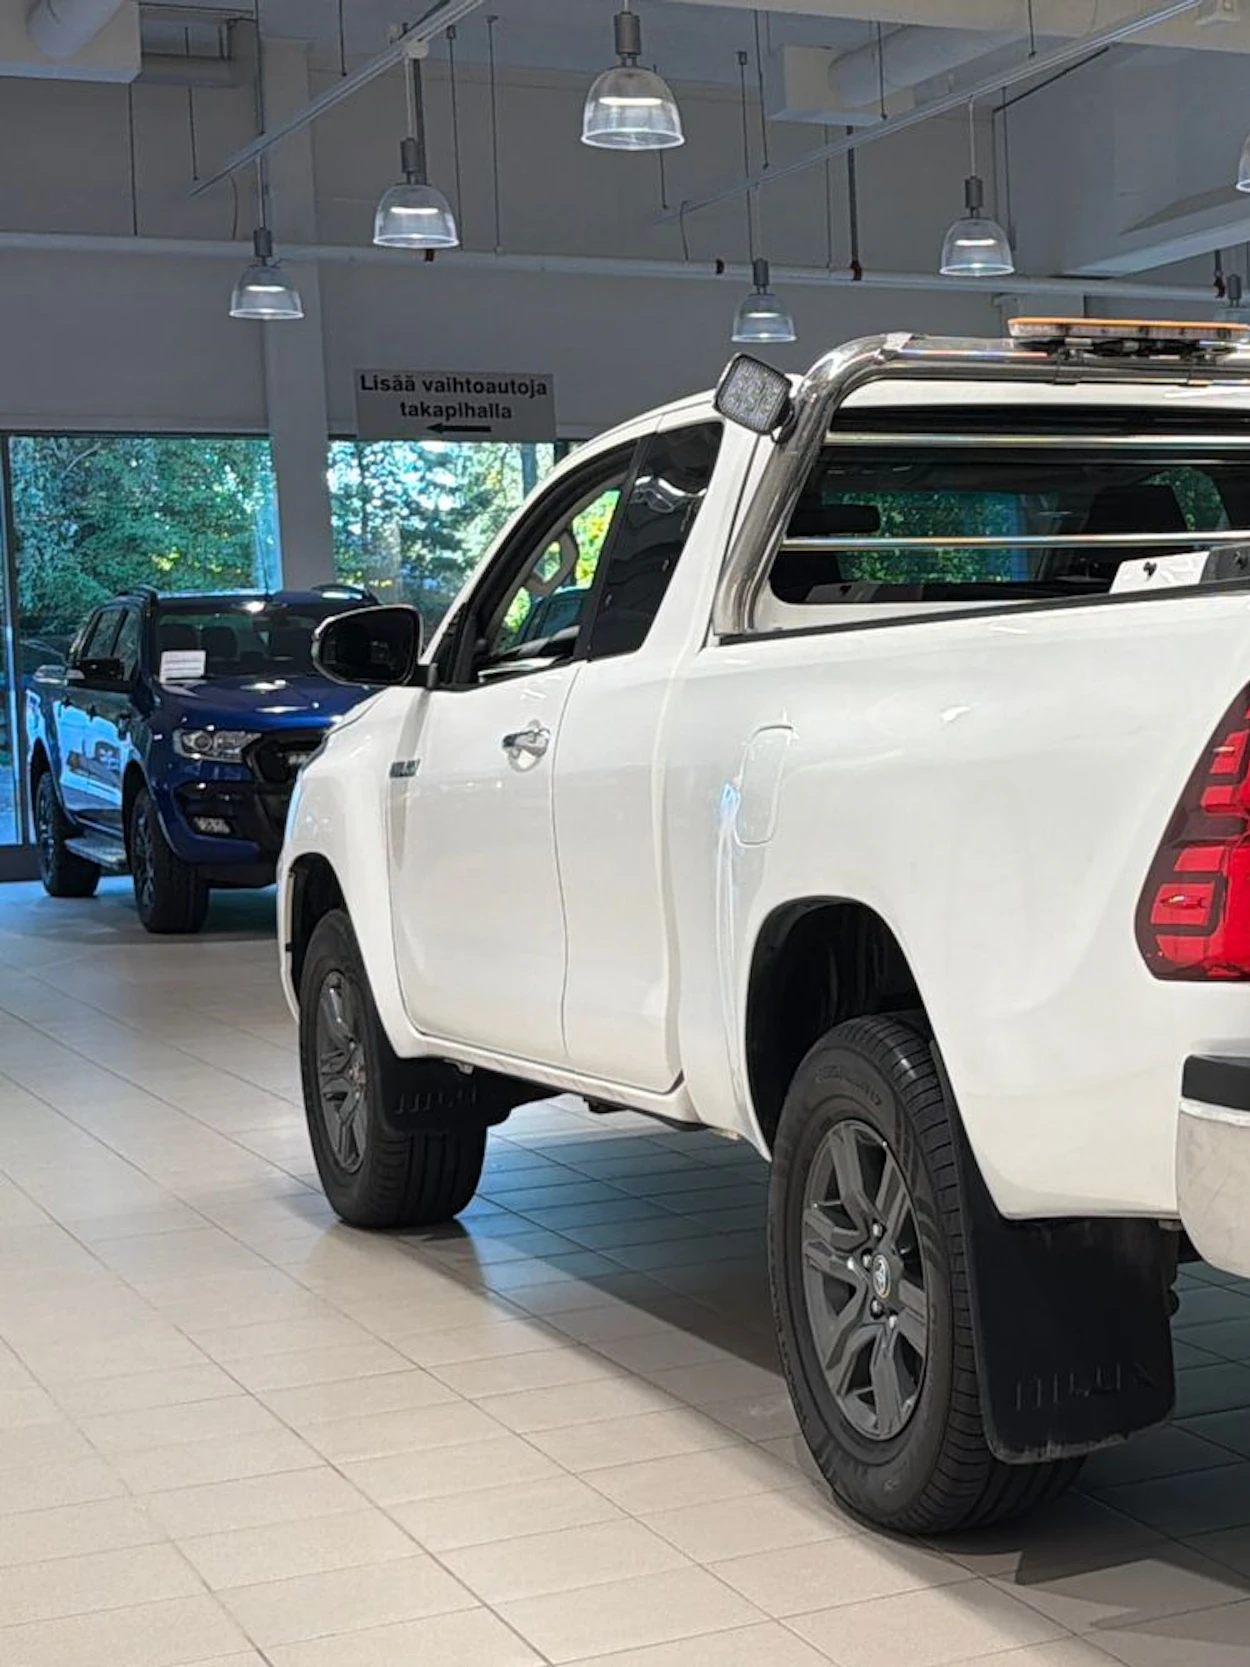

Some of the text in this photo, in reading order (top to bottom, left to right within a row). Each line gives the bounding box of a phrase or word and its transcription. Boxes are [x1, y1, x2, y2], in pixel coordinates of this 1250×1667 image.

[360, 374, 548, 399] Lisää vaihtoautoja
[400, 401, 513, 421] takapihalla
